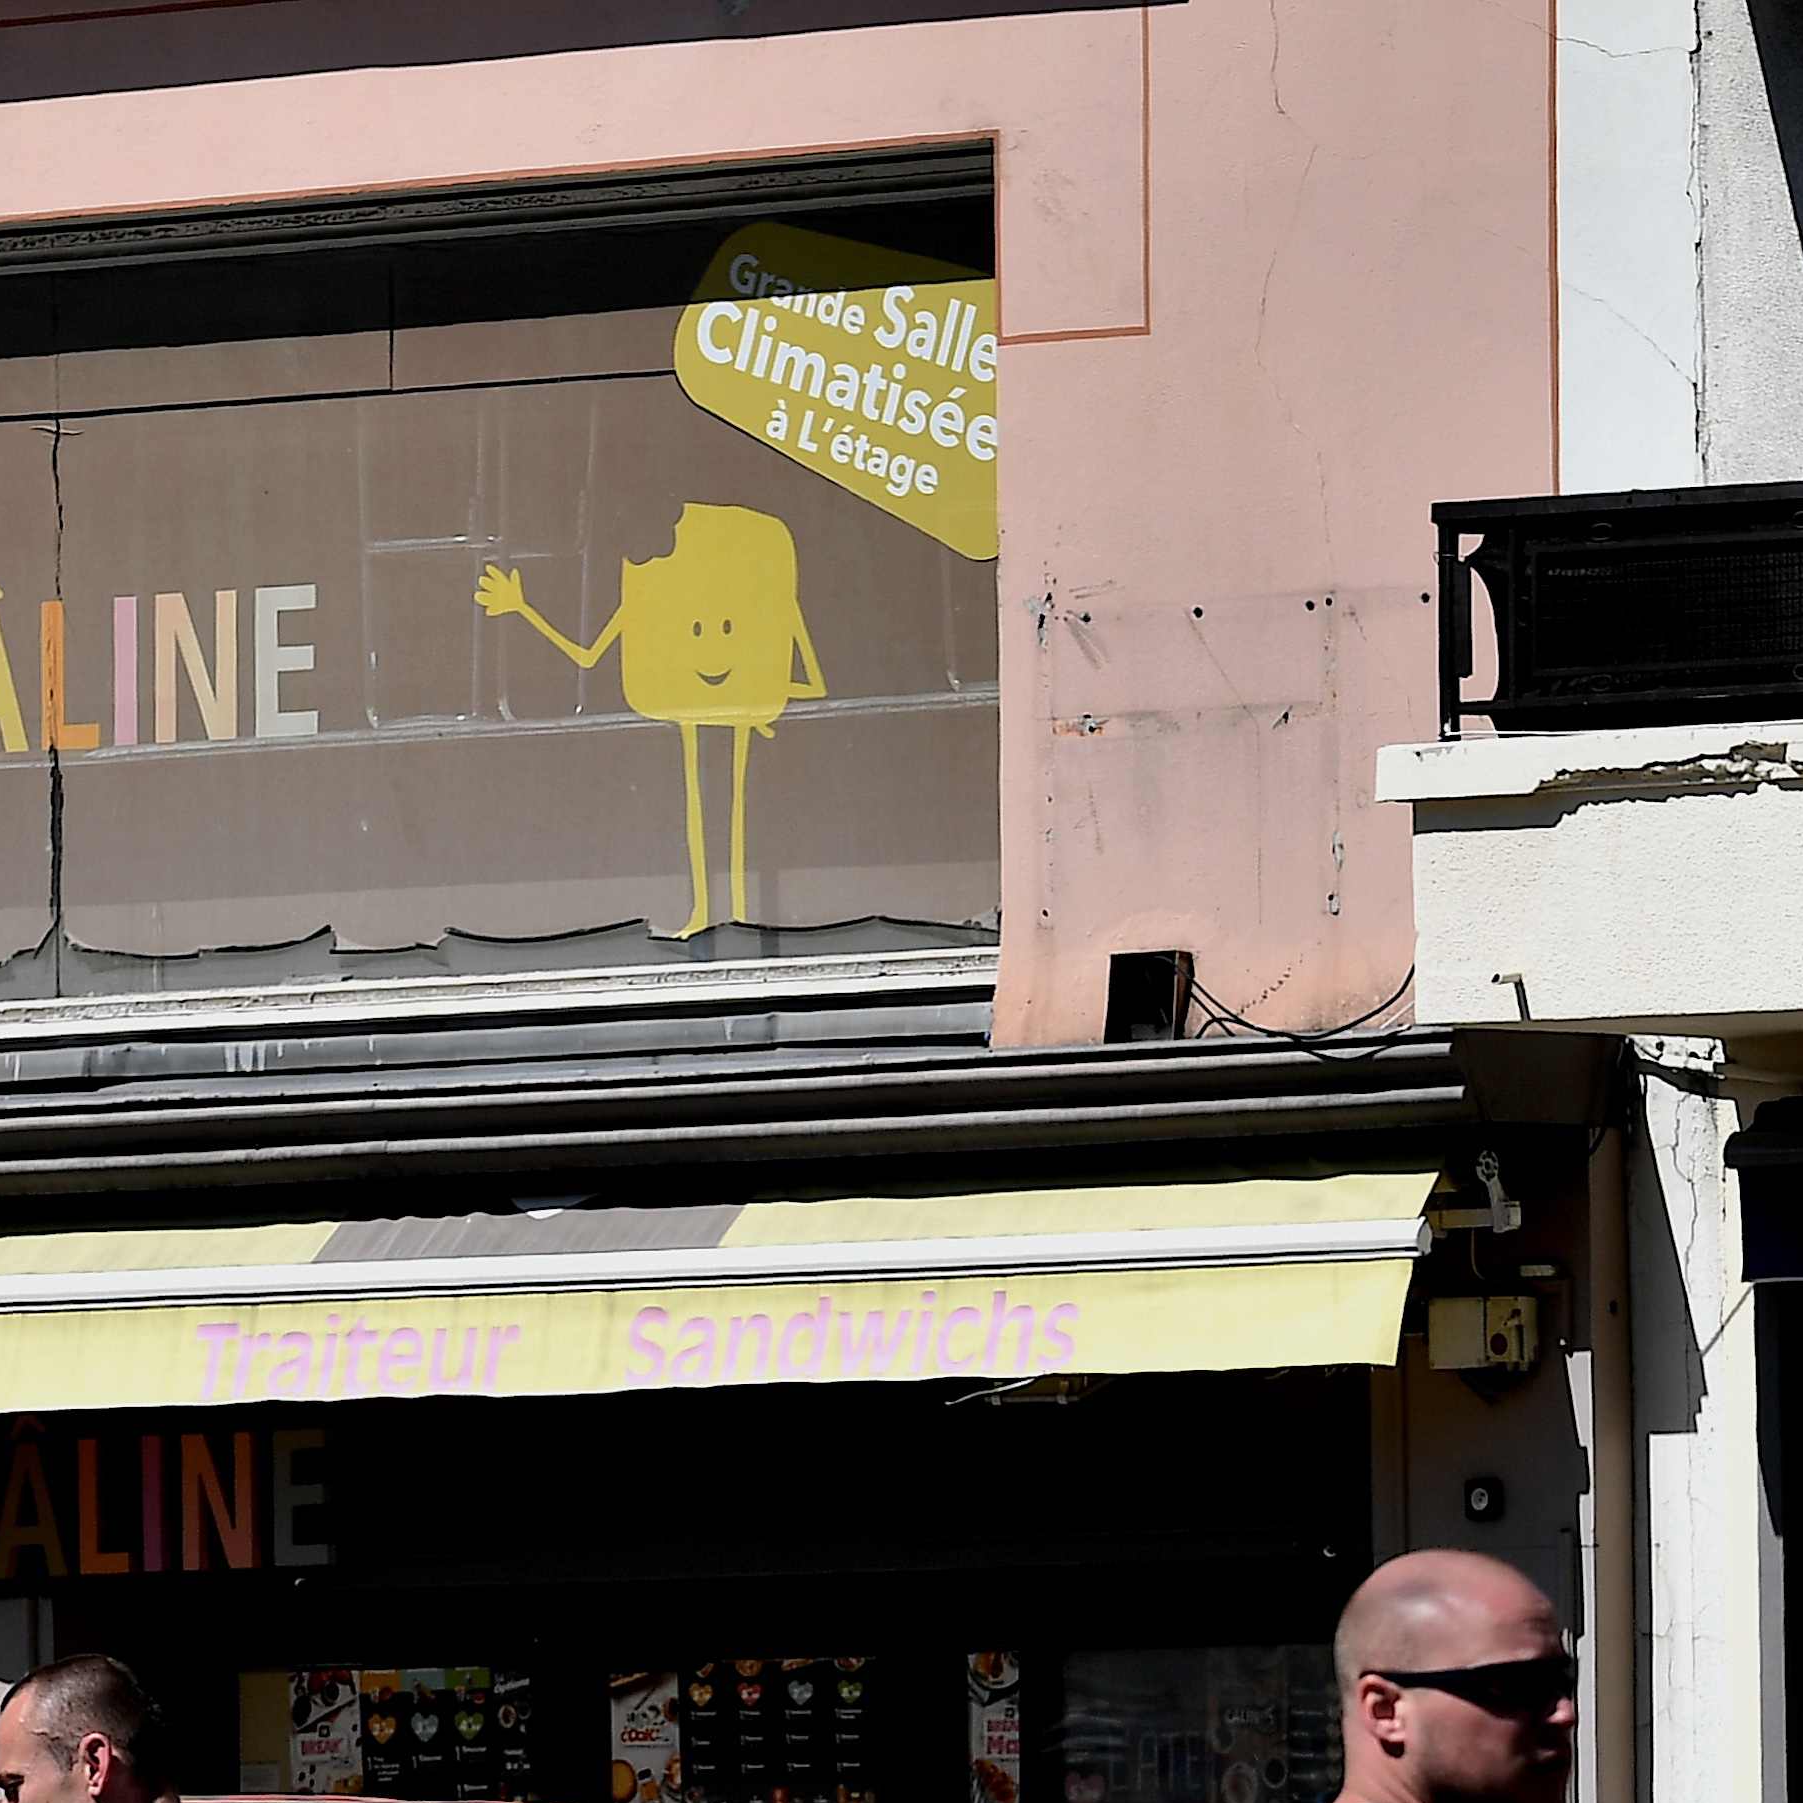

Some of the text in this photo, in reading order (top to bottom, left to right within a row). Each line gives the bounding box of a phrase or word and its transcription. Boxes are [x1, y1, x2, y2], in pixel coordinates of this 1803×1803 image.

[728, 253, 998, 383] Grande Salle
[696, 300, 998, 462] Climatisée
[765, 399, 939, 497] à L'étage
[195, 1312, 523, 1399] Traiteur
[624, 1289, 1080, 1388] Sandwichs
